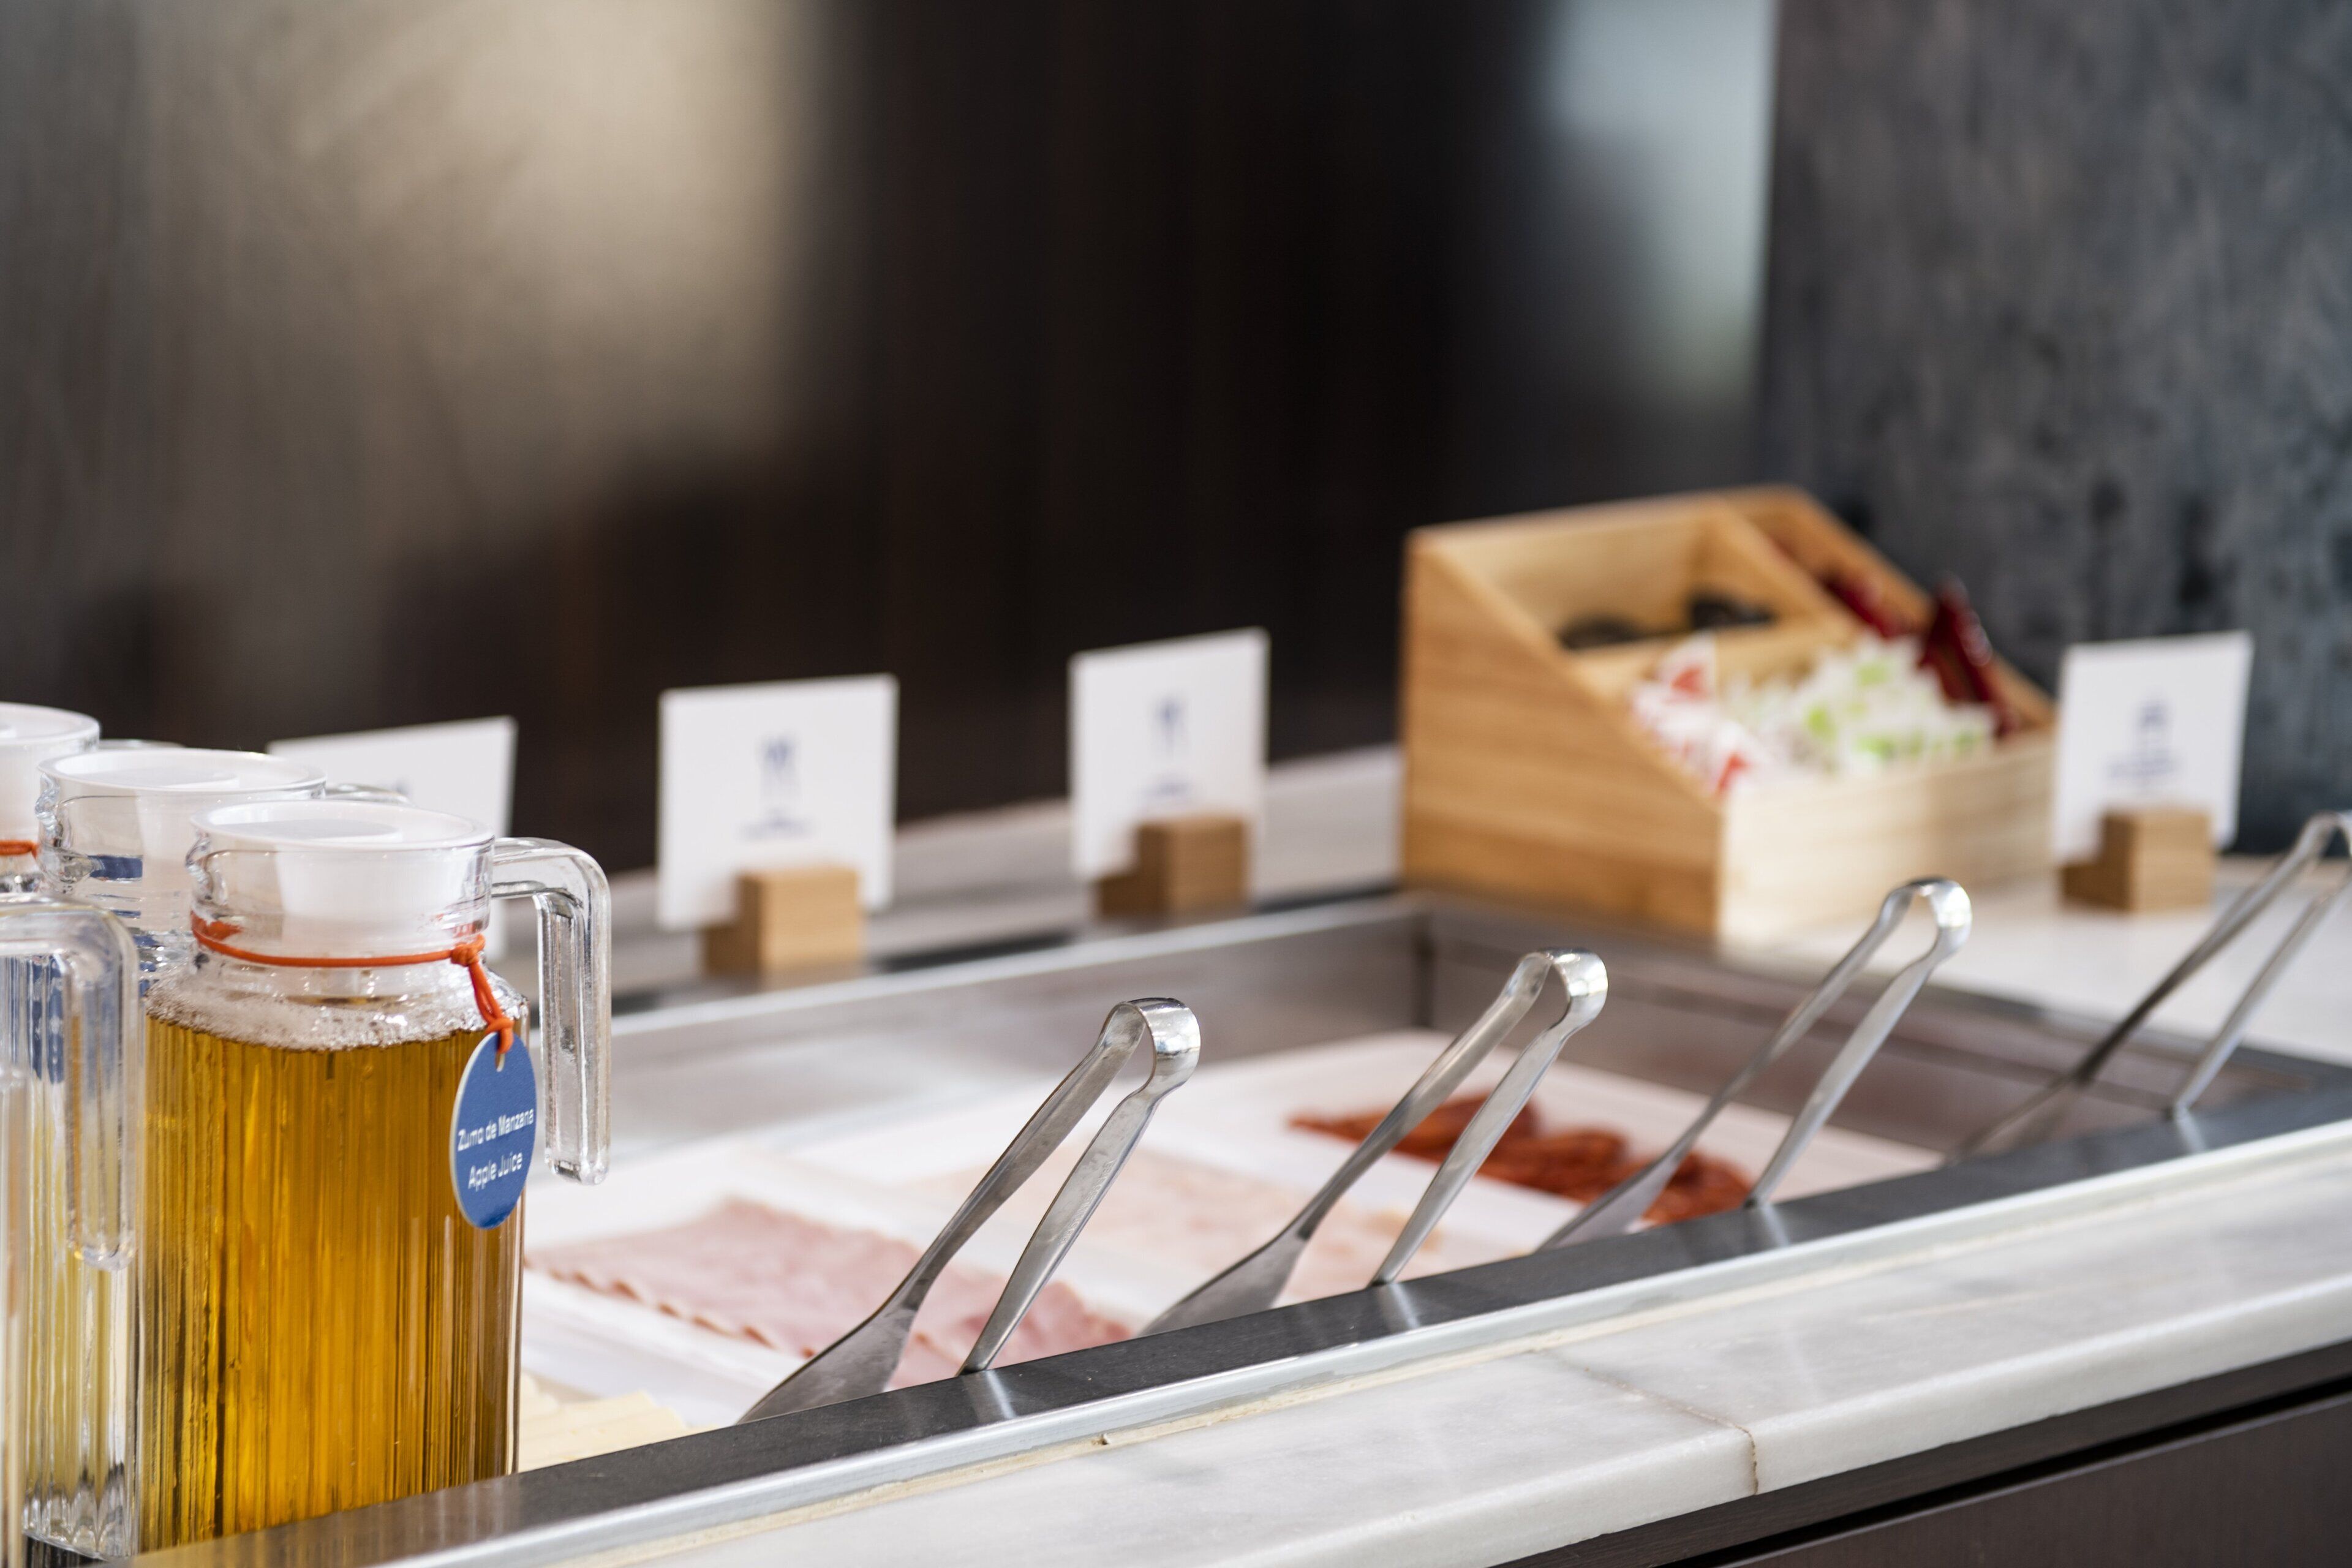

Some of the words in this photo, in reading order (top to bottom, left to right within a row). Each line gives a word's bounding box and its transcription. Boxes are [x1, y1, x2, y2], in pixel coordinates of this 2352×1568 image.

[458, 1128, 484, 1151] Zumo
[486, 1120, 497, 1141] de
[498, 1109, 534, 1136] Manzana
[468, 1160, 497, 1192] Apple
[498, 1152, 522, 1177] Juice
